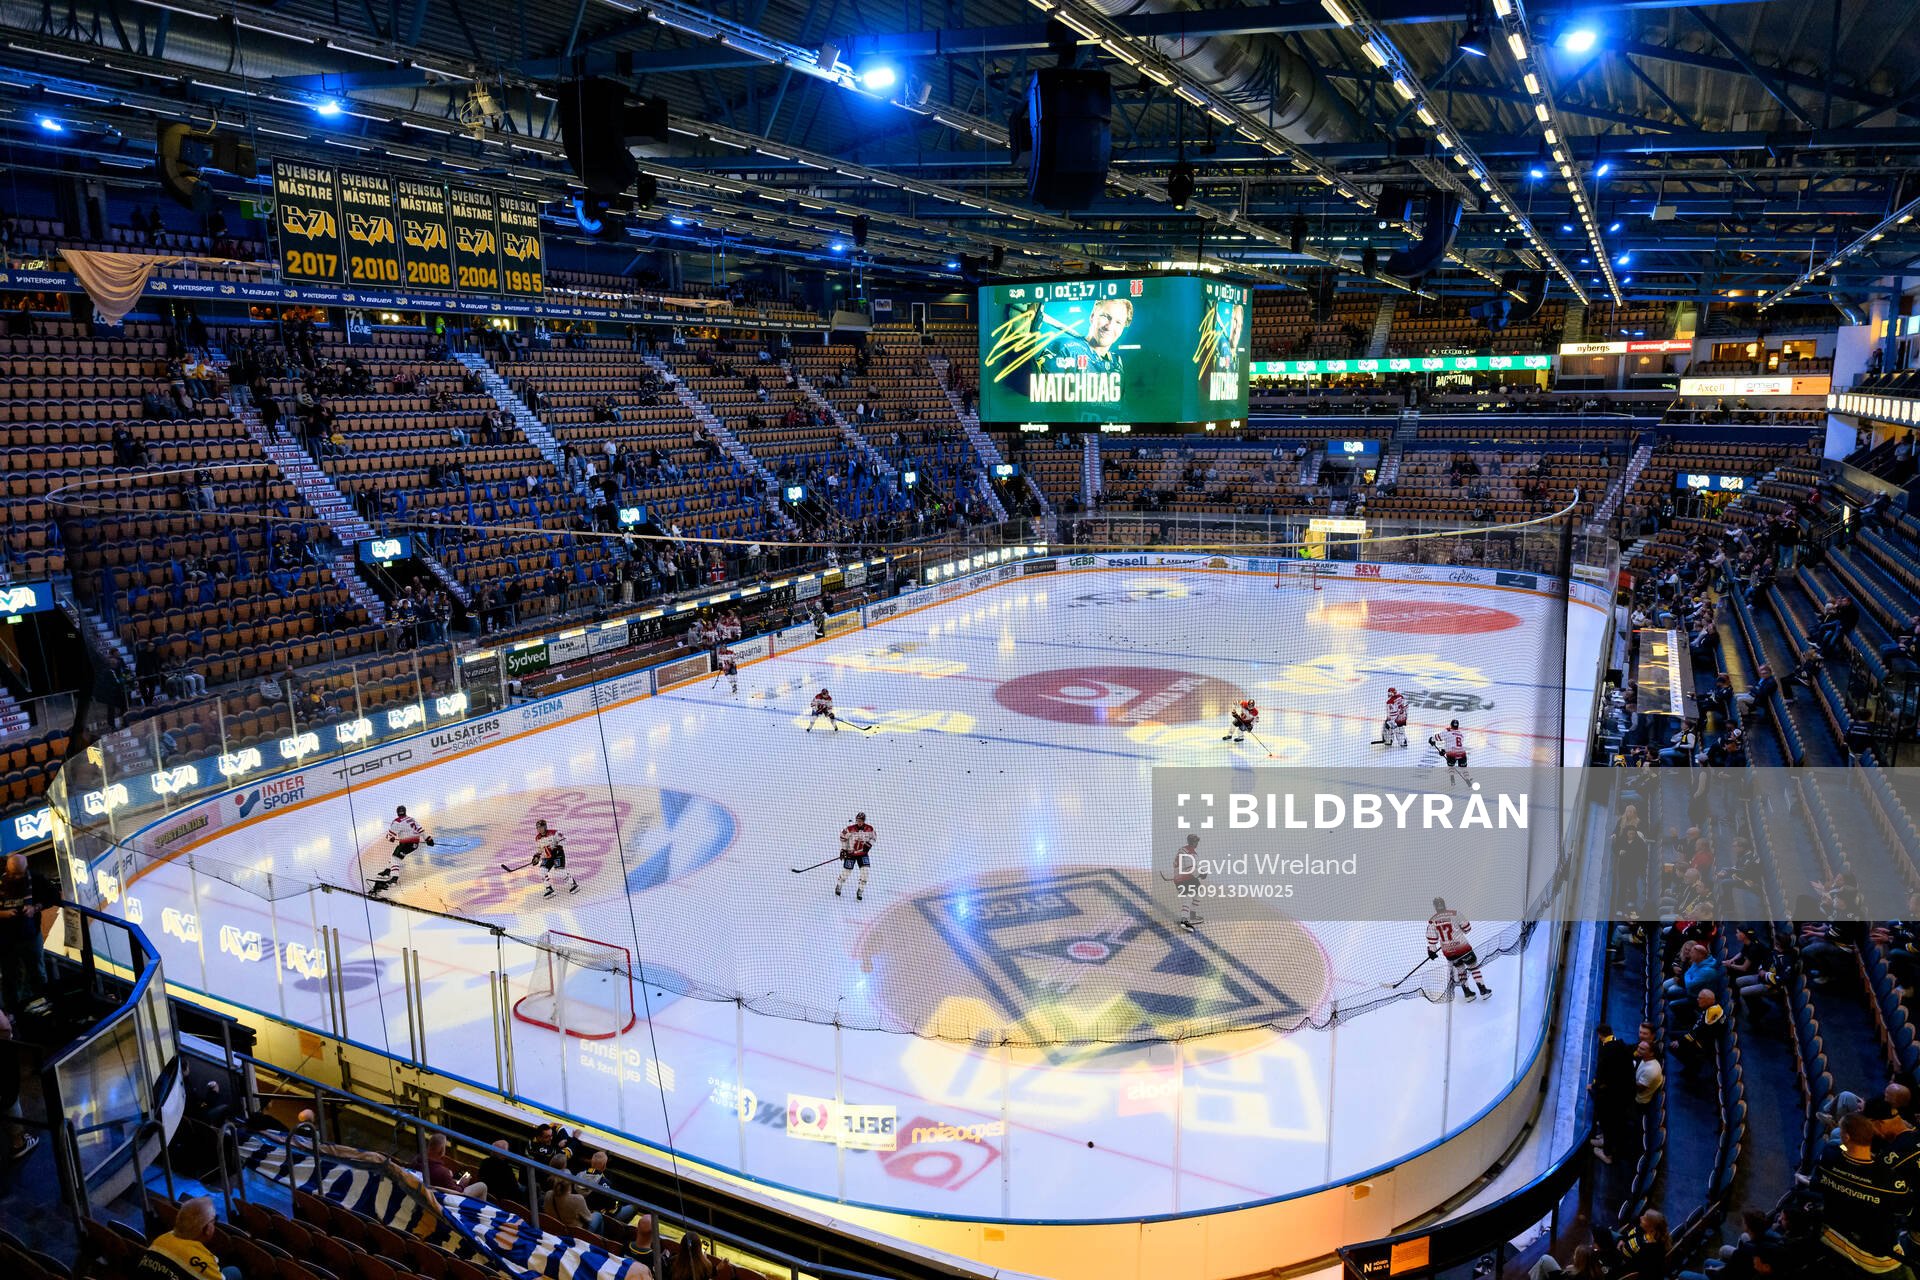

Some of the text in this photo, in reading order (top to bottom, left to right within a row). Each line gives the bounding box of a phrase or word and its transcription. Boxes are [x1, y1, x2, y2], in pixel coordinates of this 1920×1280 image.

[277, 163, 332, 184] SVENSKA
[341, 173, 389, 191] SVENSKA
[278, 180, 333, 200] MÄSTARE
[342, 188, 391, 207] MÄSTARE
[399, 181, 443, 199] SVENSKA
[451, 189, 492, 207] SVENSKA
[400, 196, 444, 214] MÄSTARE
[452, 203, 493, 221] MÄSTARE
[500, 197, 536, 214] SVENSKA
[501, 210, 538, 228] MÄSTARE
[287, 250, 337, 277] 2017
[352, 256, 399, 281] 2010
[407, 261, 450, 285] 2008
[458, 266, 498, 289] 2004
[505, 270, 541, 293] 1995
[17, 276, 66, 285] INTERSPORT
[173, 284, 215, 292] INTERSPORT
[303, 292, 338, 300] INTERSPORT
[1035, 287, 1045, 299] 0
[1054, 283, 1095, 298] 01:17
[1107, 283, 1118, 296] 0
[1576, 344, 1610, 353] nybergs
[1029, 372, 1122, 403] MATCHDAG
[1108, 556, 1148, 567] essell
[1355, 564, 1381, 574] SEW
[508, 647, 547, 673] Sydved
[531, 698, 564, 720] STENA
[430, 718, 500, 749] ULLSÄTERS
[452, 735, 483, 752] SCHAKT
[262, 775, 305, 798] INTER
[263, 787, 306, 811] SPORT
[1436, 923, 1454, 942] 17
[1828, 1178, 1881, 1204] Husqvarna
[1364, 1262, 1372, 1273] N
